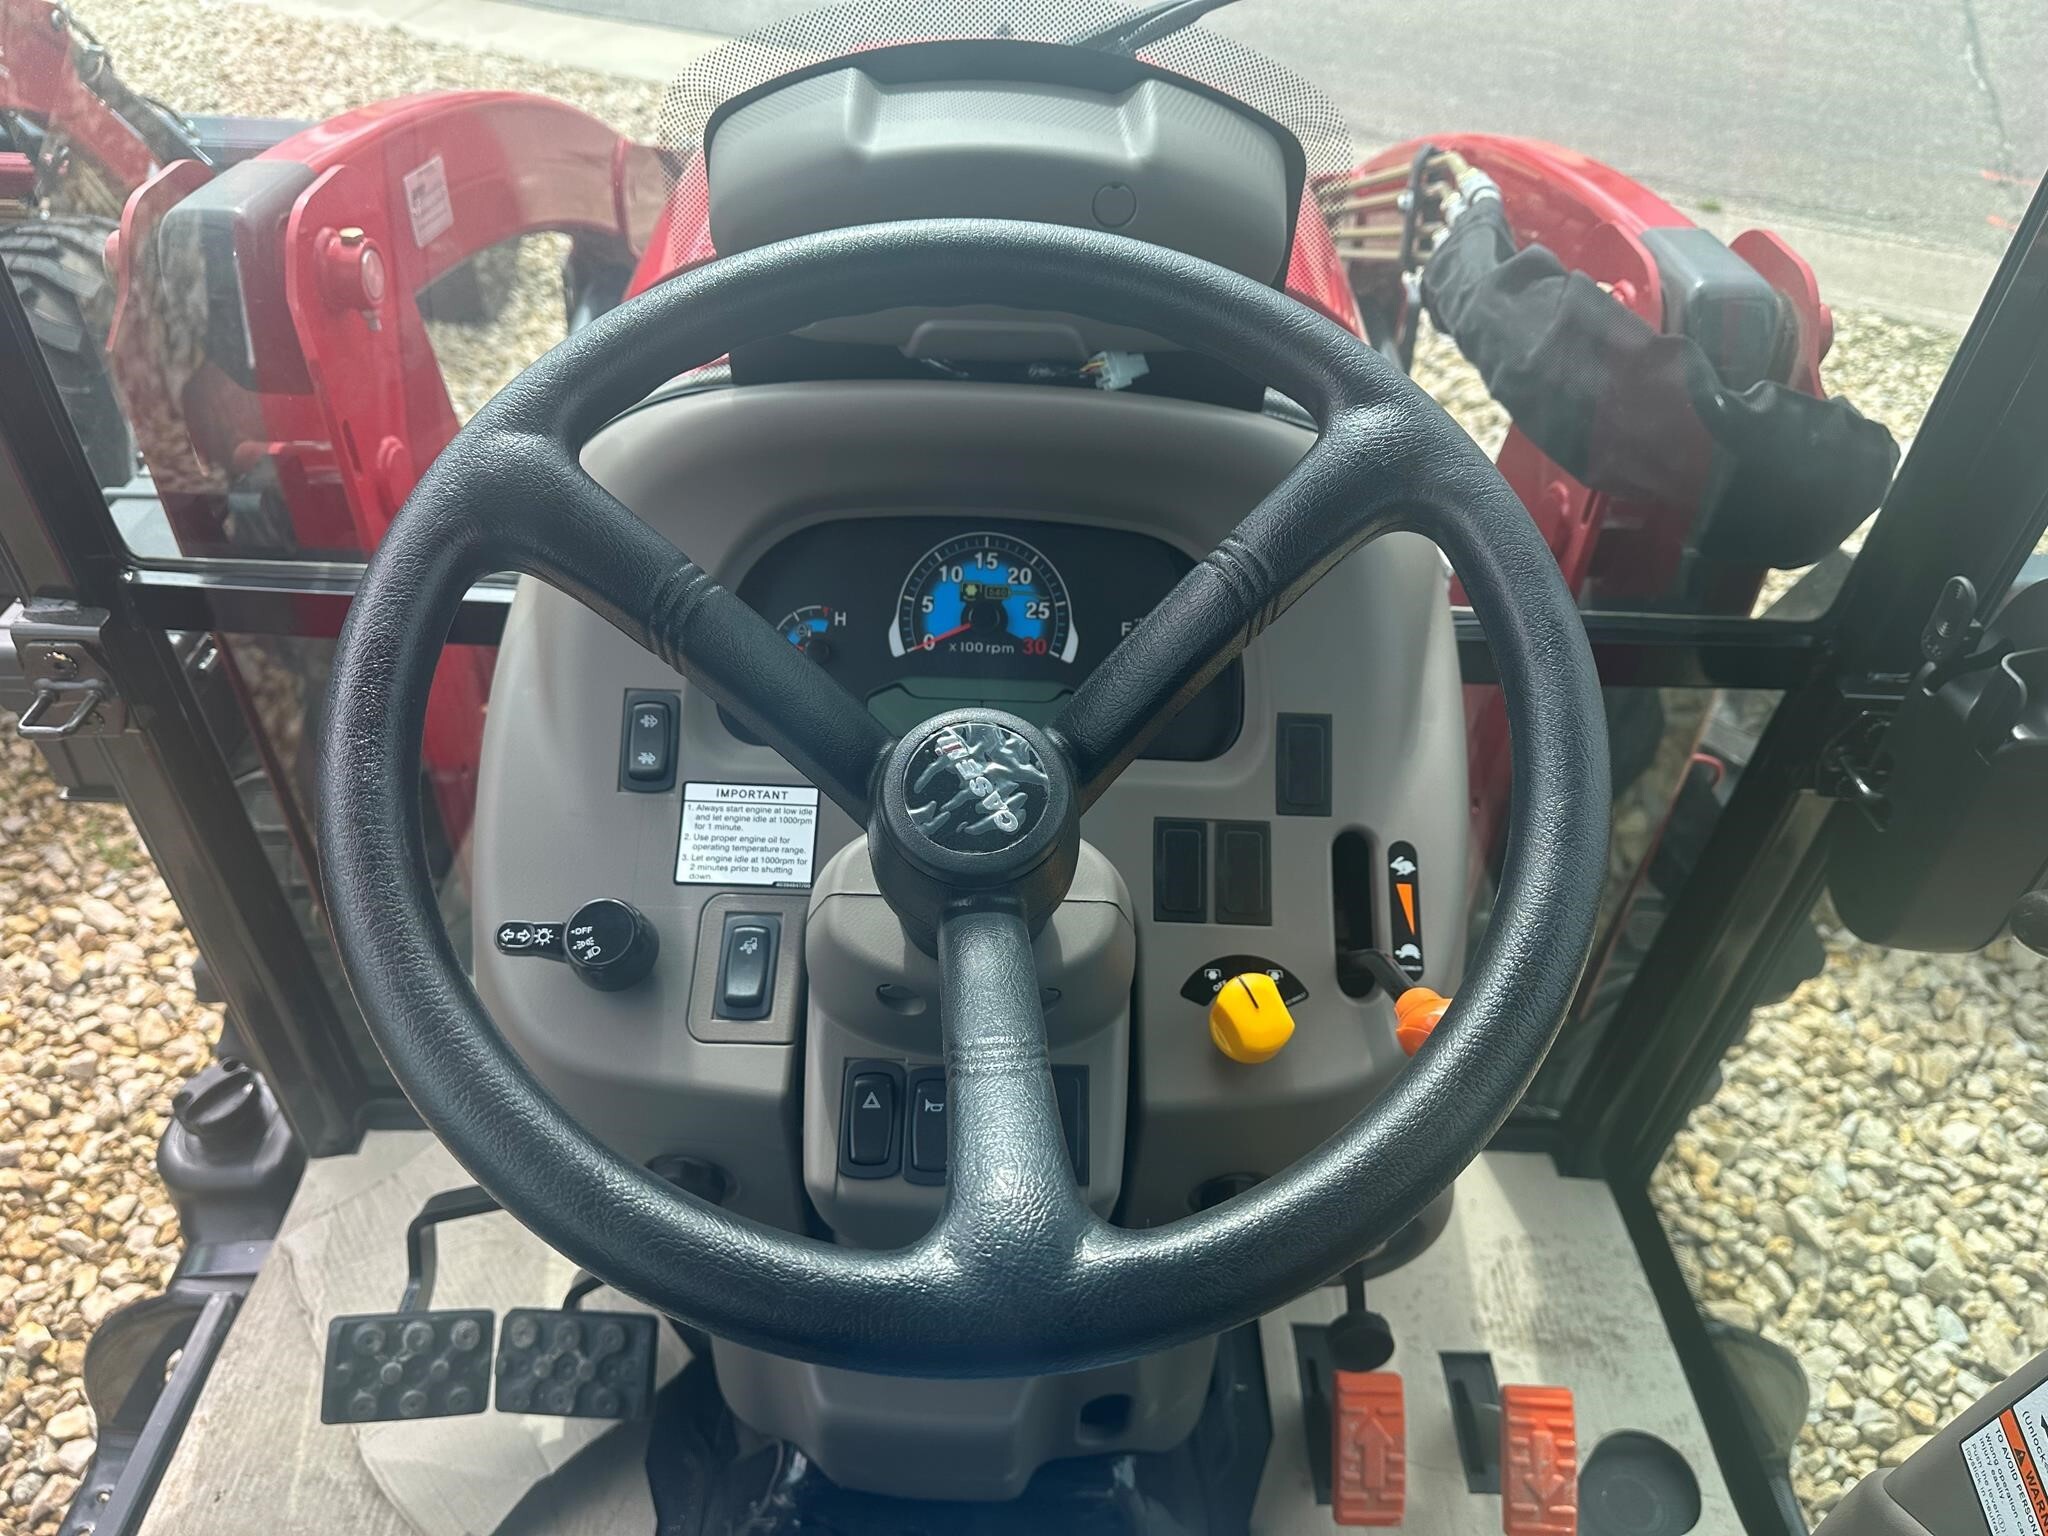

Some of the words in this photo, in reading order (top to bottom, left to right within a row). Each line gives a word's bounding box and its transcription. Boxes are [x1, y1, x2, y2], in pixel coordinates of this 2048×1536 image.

[974, 552, 998, 569] 15
[939, 565, 963, 583] 10
[1008, 567, 1032, 584] 20
[922, 596, 934, 613] 5
[1026, 602, 1050, 619] 25
[834, 611, 847, 627] H
[1121, 621, 1132, 637] F
[923, 634, 936, 650] 0
[960, 642, 984, 651] 100
[986, 643, 1015, 654] rpm
[1023, 639, 1047, 655] 30
[716, 788, 788, 800] IMPORTANT
[696, 804, 724, 813] Always
[745, 807, 772, 815] engine
[694, 822, 704, 830] for
[724, 814, 751, 823] engine
[753, 815, 767, 823] idle
[779, 816, 812, 826] 1000rpm
[693, 833, 709, 841] Use
[711, 835, 737, 843] proper
[739, 836, 766, 844] engine
[780, 836, 790, 844] for
[692, 844, 730, 853] operating
[732, 845, 780, 854] temperature
[781, 847, 806, 855] range.
[691, 853, 704, 861] Let
[705, 855, 732, 864] engine
[734, 855, 749, 863] idle
[761, 857, 795, 866] 1000rpm
[697, 864, 728, 872] minutes
[730, 865, 749, 873] prior
[761, 866, 793, 875] shutting
[575, 926, 593, 935] OFF
[1979, 1437, 1992, 1466] injury
[1972, 1443, 1982, 1468] Push
[1980, 1469, 1989, 1486] the
[1985, 1433, 1999, 1466] Wrong
[1998, 1468, 2018, 1518] operation
[1996, 1428, 2003, 1442] TO
[2002, 1447, 2018, 1481] AVOID
[2016, 1484, 2040, 1536] PERSON
[1965, 1447, 1981, 1485] joystick
[1980, 1487, 1986, 1497] in
[1984, 1499, 2000, 1535] neutral
